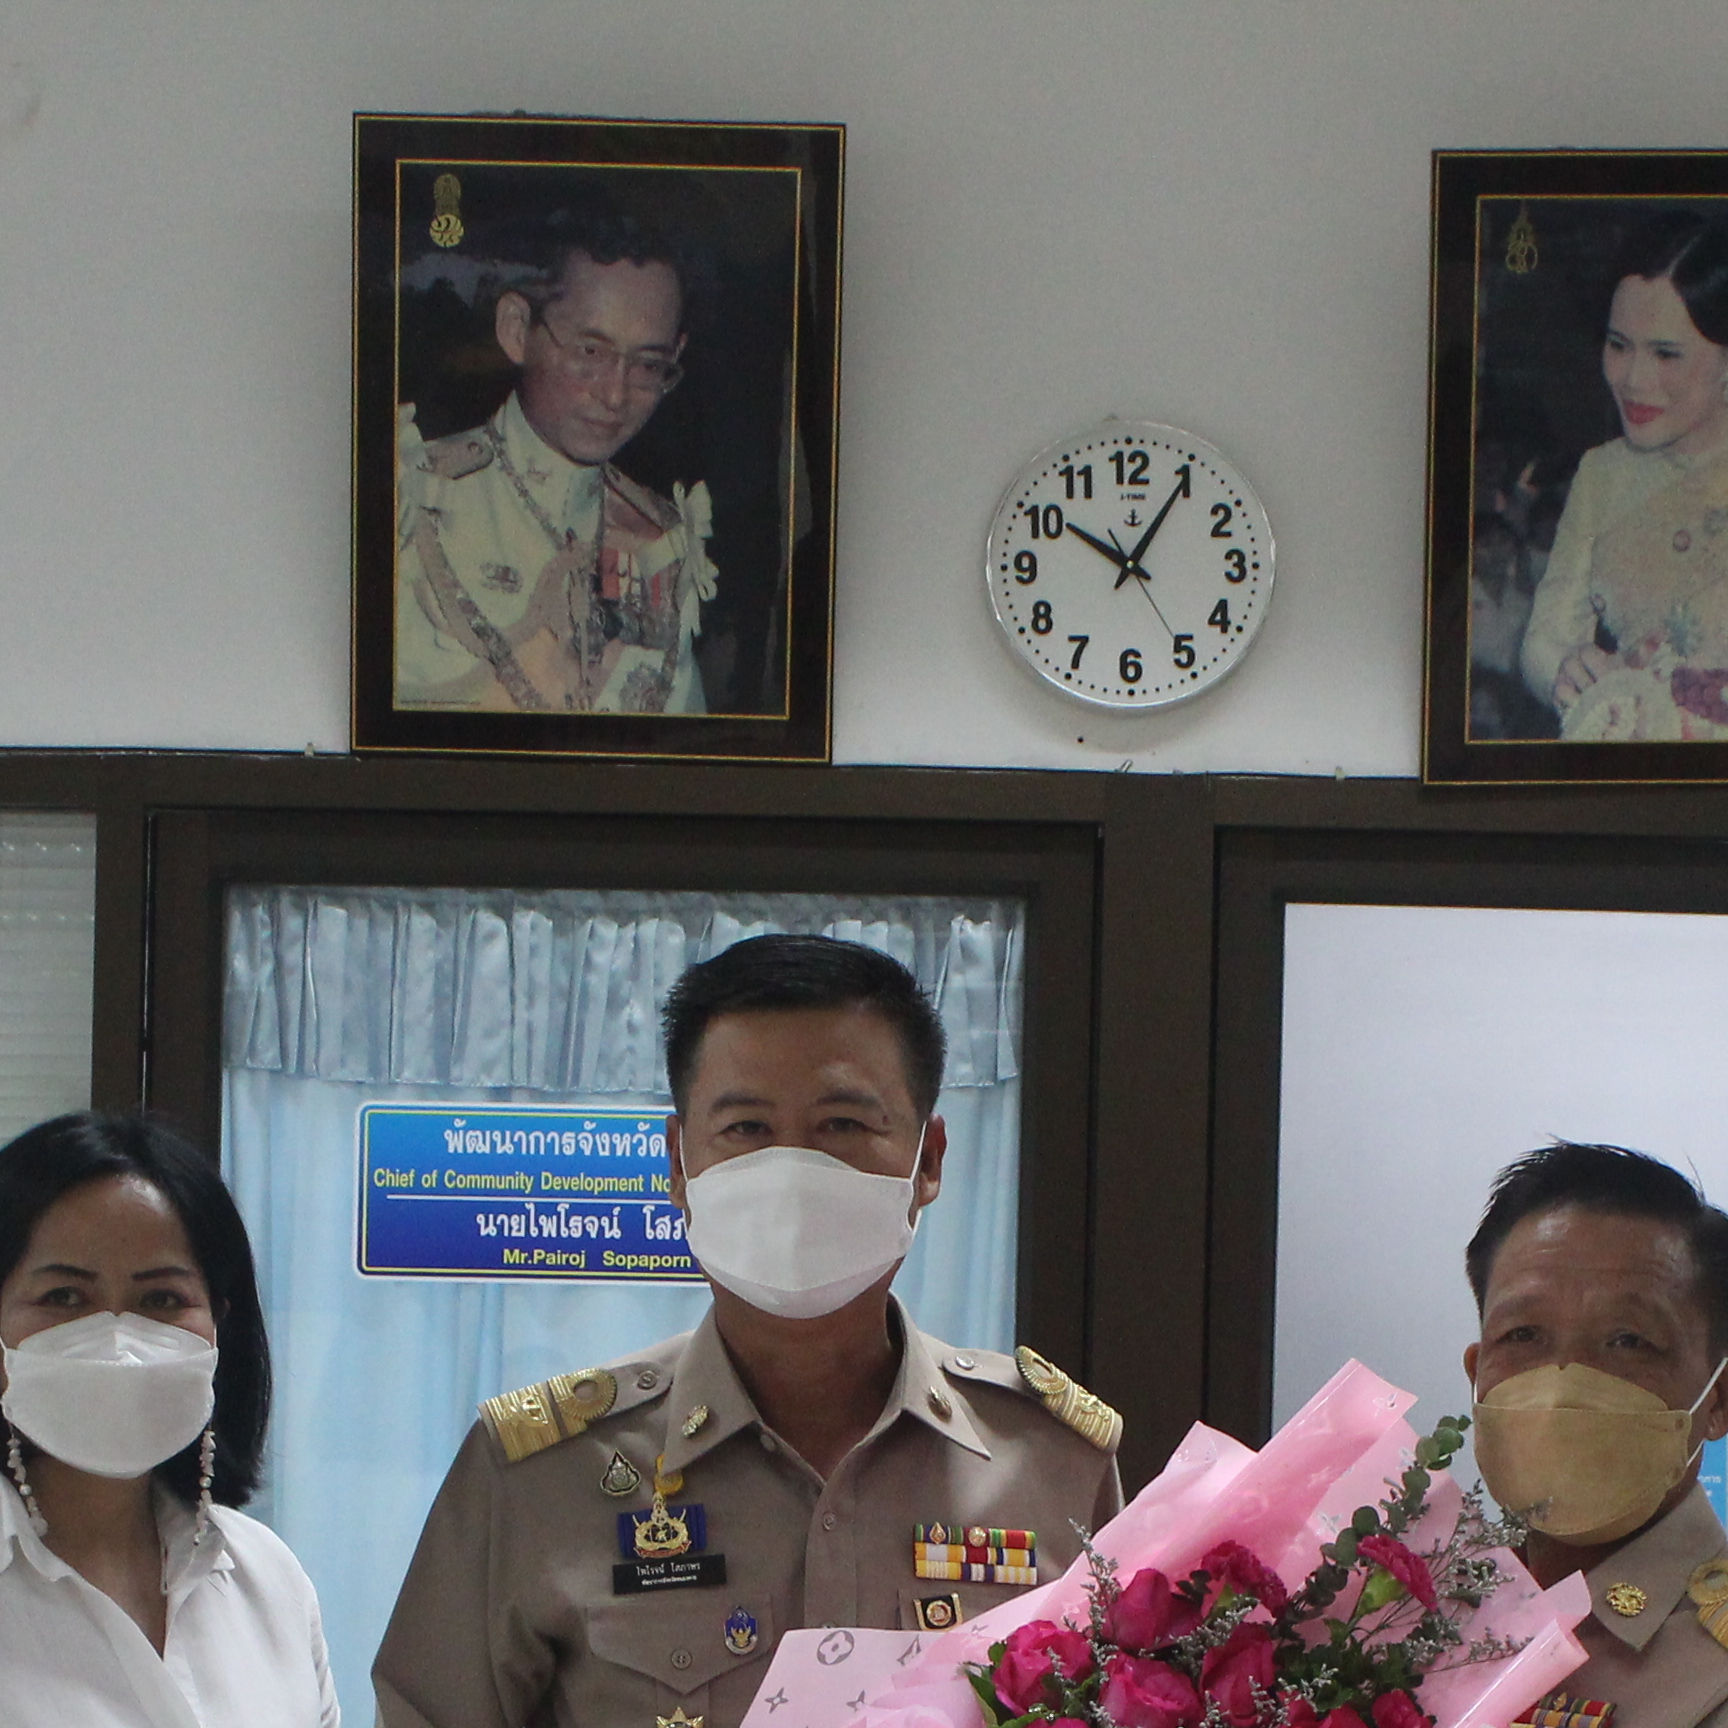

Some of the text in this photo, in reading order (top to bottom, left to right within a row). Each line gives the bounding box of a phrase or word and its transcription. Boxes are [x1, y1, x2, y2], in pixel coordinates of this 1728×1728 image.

[1059, 464, 1093, 499] 11
[1108, 450, 1150, 485] 12
[1175, 464, 1191, 498] 1
[1024, 504, 1064, 539] 10
[1210, 503, 1233, 538] 2
[1014, 550, 1037, 584] 9
[1224, 548, 1247, 583] 3
[1031, 600, 1054, 634] 8
[1207, 598, 1231, 633] 4
[1068, 634, 1090, 669] 7
[1119, 648, 1143, 683] 6
[1173, 634, 1196, 669] 5
[444, 1118, 666, 1158] พัฒนาการจังหวัด
[373, 1168, 415, 1188] Chief
[422, 1169, 439, 1188] of
[444, 1170, 534, 1195] Community
[541, 1171, 644, 1195] Development
[476, 1202, 622, 1240] นายไพโรจน์
[503, 1249, 691, 1270] Mr.Pairoj Sopaporn
